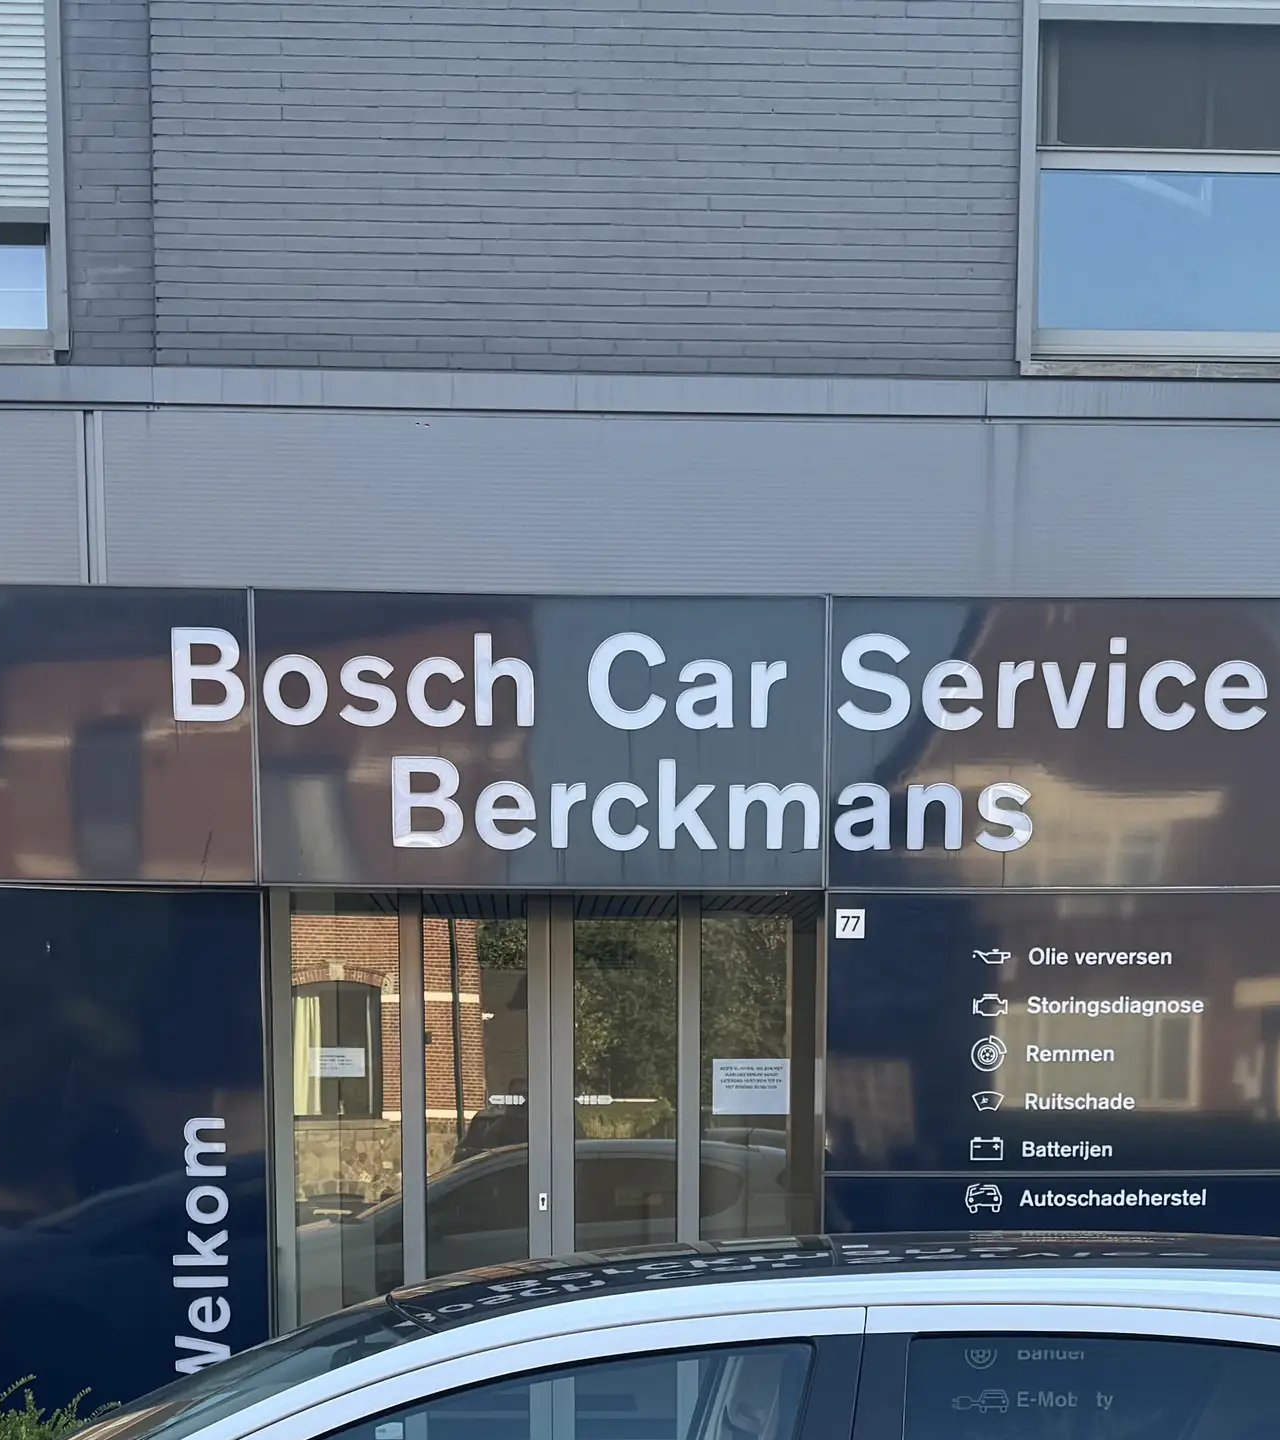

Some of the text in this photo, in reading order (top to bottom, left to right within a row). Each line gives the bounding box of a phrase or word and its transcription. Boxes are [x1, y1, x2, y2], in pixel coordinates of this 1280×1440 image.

[170, 626, 1269, 732] Bosch Car Service
[391, 755, 1034, 852] Berckmans
[840, 915, 861, 932] 77
[1028, 947, 1173, 966] Olie verversen
[1026, 995, 1205, 1017] Storingsdiagnose
[1025, 1045, 1115, 1063] Remmen
[1024, 1092, 1136, 1112] Ruitschade
[1021, 1140, 1113, 1161] Batterijen
[1018, 1188, 1207, 1208] Autoschadeherstel
[1016, 1390, 1114, 1409] E-Mobty
